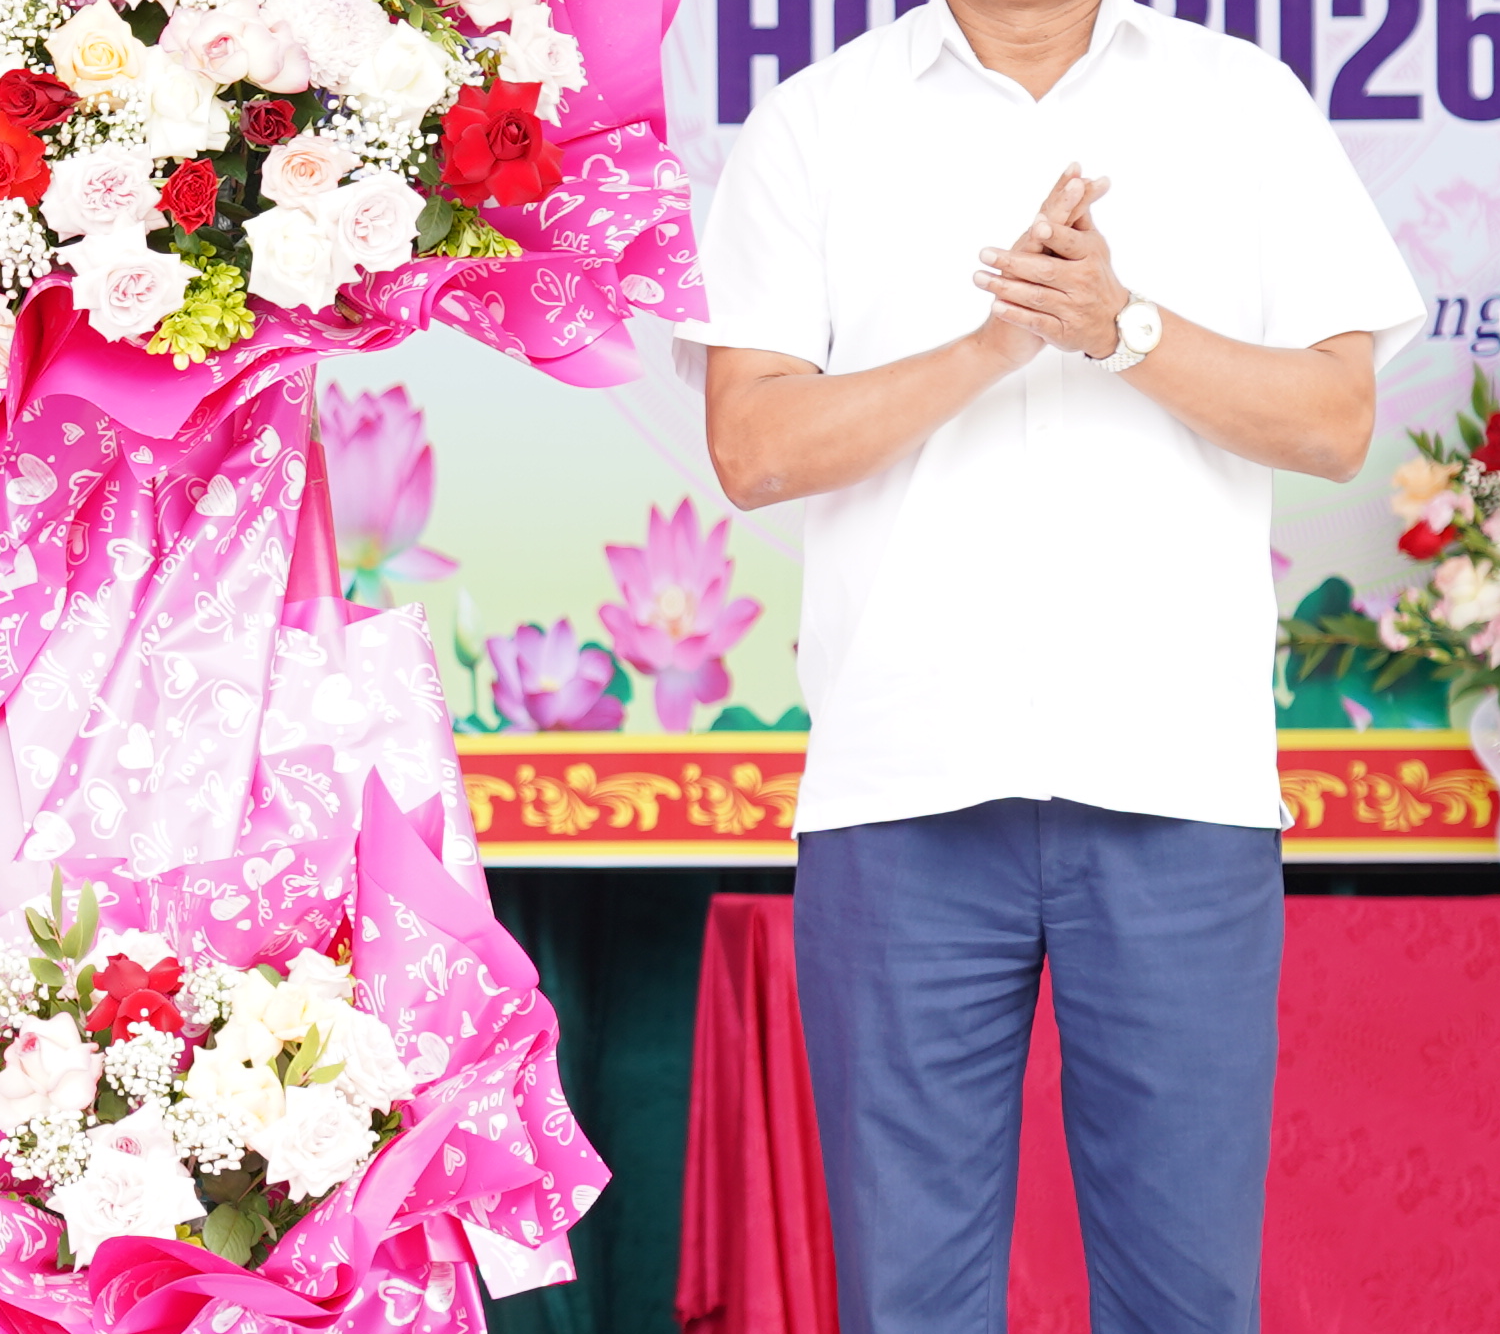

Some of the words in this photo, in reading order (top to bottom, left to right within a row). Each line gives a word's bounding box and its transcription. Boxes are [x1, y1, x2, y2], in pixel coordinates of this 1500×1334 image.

[551, 228, 590, 250] LOVE
[551, 303, 596, 348] LOVE
[99, 479, 120, 534] LOVE
[239, 505, 278, 551] love
[154, 536, 194, 585] LOVE
[134, 611, 174, 666] love
[275, 758, 333, 795] LOVE
[180, 875, 239, 900] LOVE
[541, 1170, 570, 1232] love
